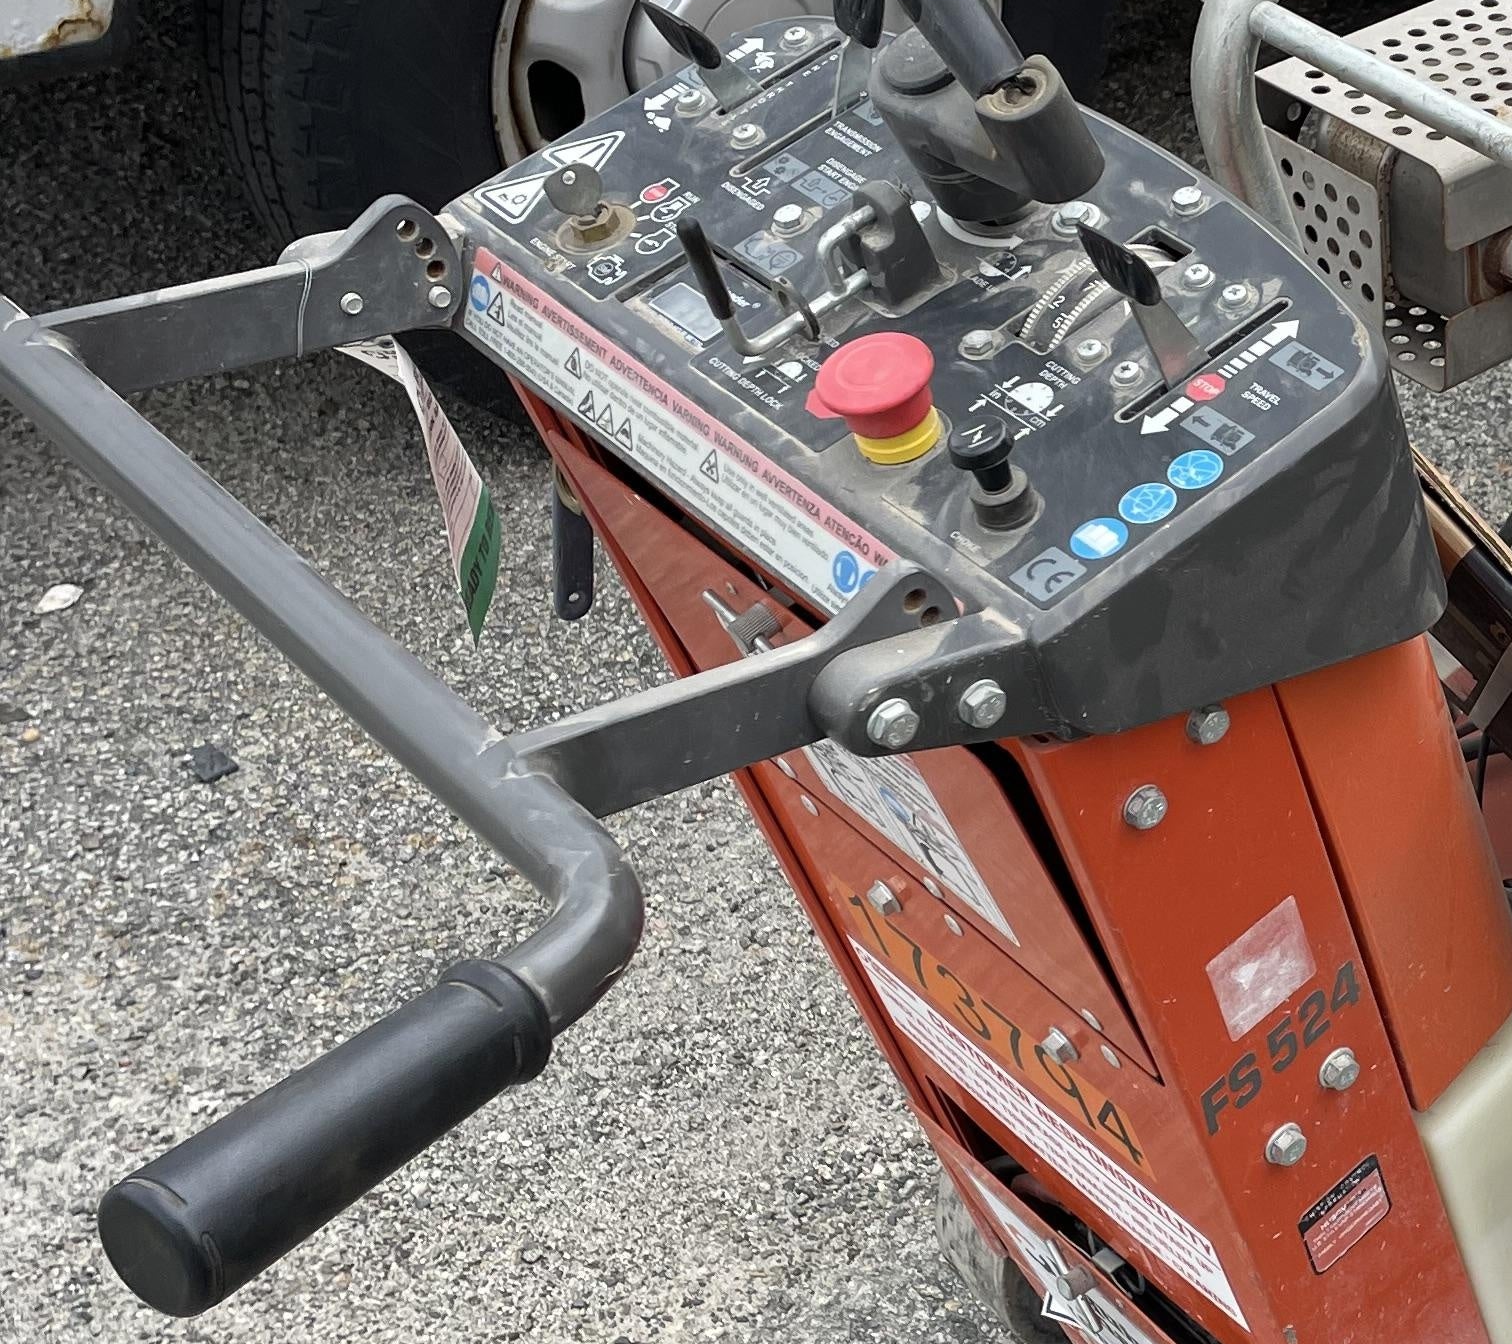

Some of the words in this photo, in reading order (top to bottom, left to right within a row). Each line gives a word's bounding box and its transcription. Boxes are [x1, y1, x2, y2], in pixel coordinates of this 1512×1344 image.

[708, 357, 739, 381] CUTTING
[759, 391, 785, 410] LOCK
[1044, 360, 1081, 386] CUTTING
[1192, 379, 1223, 395] STOP
[1250, 382, 1281, 406] TRAVEL
[1241, 391, 1272, 411] SPEED
[1200, 1052, 1262, 1136] FS
[1266, 960, 1360, 1073] 524
[926, 1008, 1032, 1108] CUSTOMER
[1034, 1102, 1212, 1257] RESPONSIBILITY
